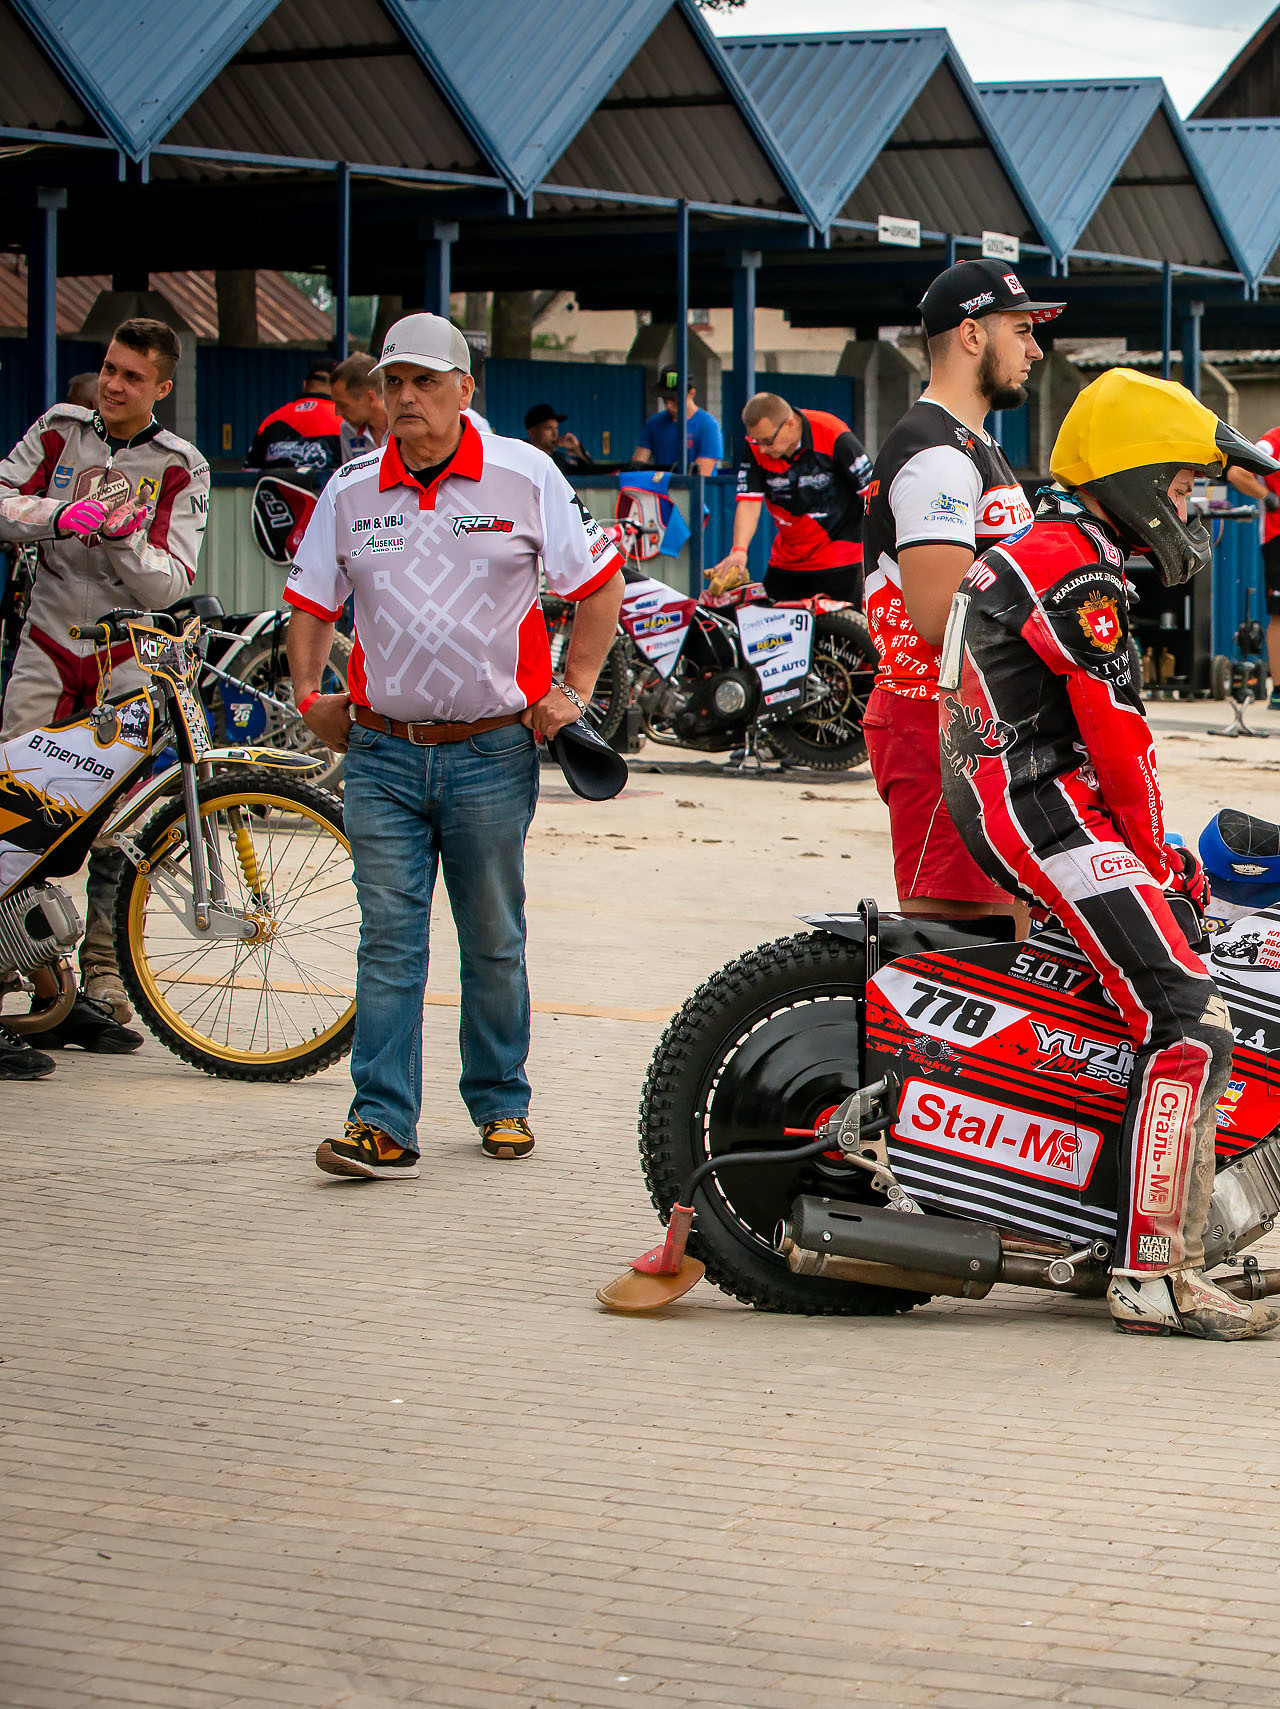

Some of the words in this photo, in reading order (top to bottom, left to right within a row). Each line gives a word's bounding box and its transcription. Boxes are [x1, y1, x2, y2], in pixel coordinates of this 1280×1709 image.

[351, 519, 371, 533] JBM
[373, 517, 382, 529] &
[384, 514, 404, 528] VBJ
[789, 614, 808, 631] #91
[781, 659, 807, 673] AUTO
[894, 651, 928, 675] #778
[233, 709, 251, 722] 26
[1010, 953, 1082, 988] S.O.T
[905, 981, 997, 1038] 778
[1046, 1055, 1088, 1075] MX
[911, 1093, 1064, 1166] Stal-M
[1150, 1092, 1179, 1194] Сталь-М
[1139, 1235, 1170, 1246] MALI
